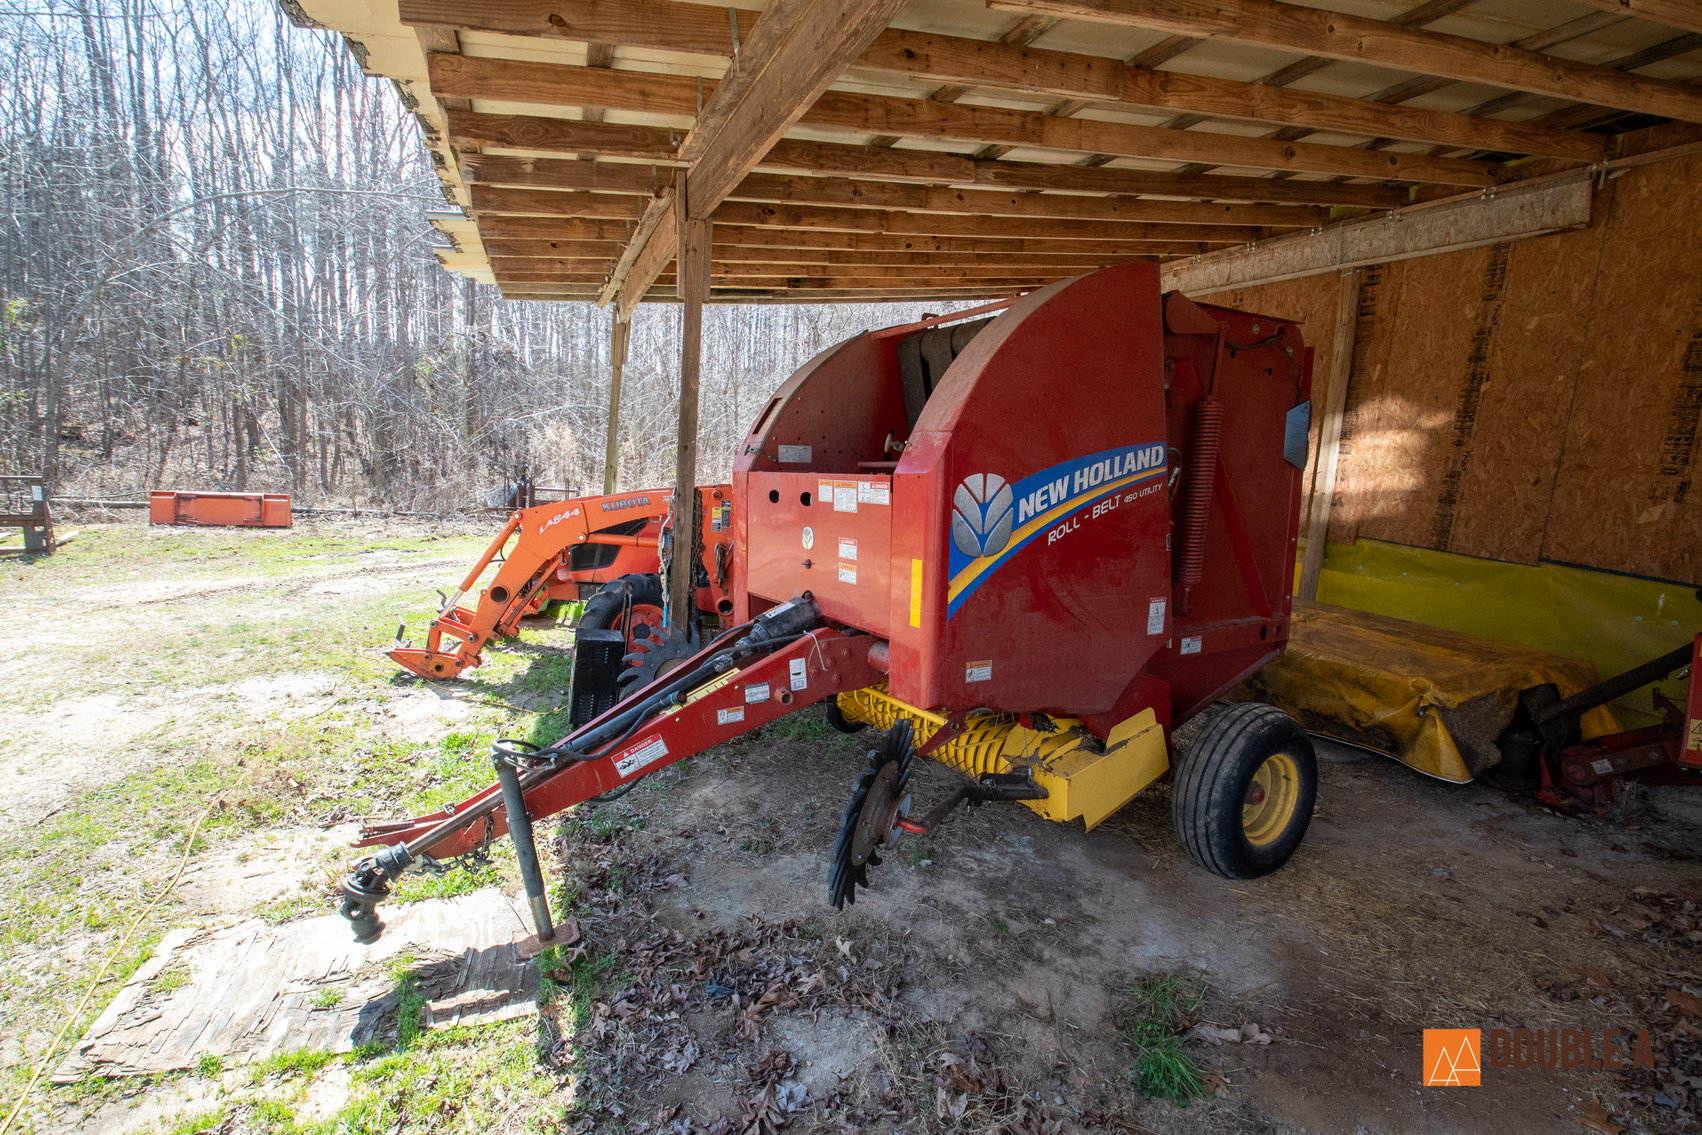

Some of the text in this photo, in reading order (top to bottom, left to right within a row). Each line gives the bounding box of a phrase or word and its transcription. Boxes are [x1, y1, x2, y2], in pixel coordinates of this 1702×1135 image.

[602, 496, 651, 512] KUBOTA
[1018, 445, 1164, 524] NEW HOLLAND
[1047, 516, 1081, 546] ROLL
[1092, 494, 1122, 520] BELT
[1139, 483, 1163, 498] UTILITY
[630, 739, 653, 754] DANGER
